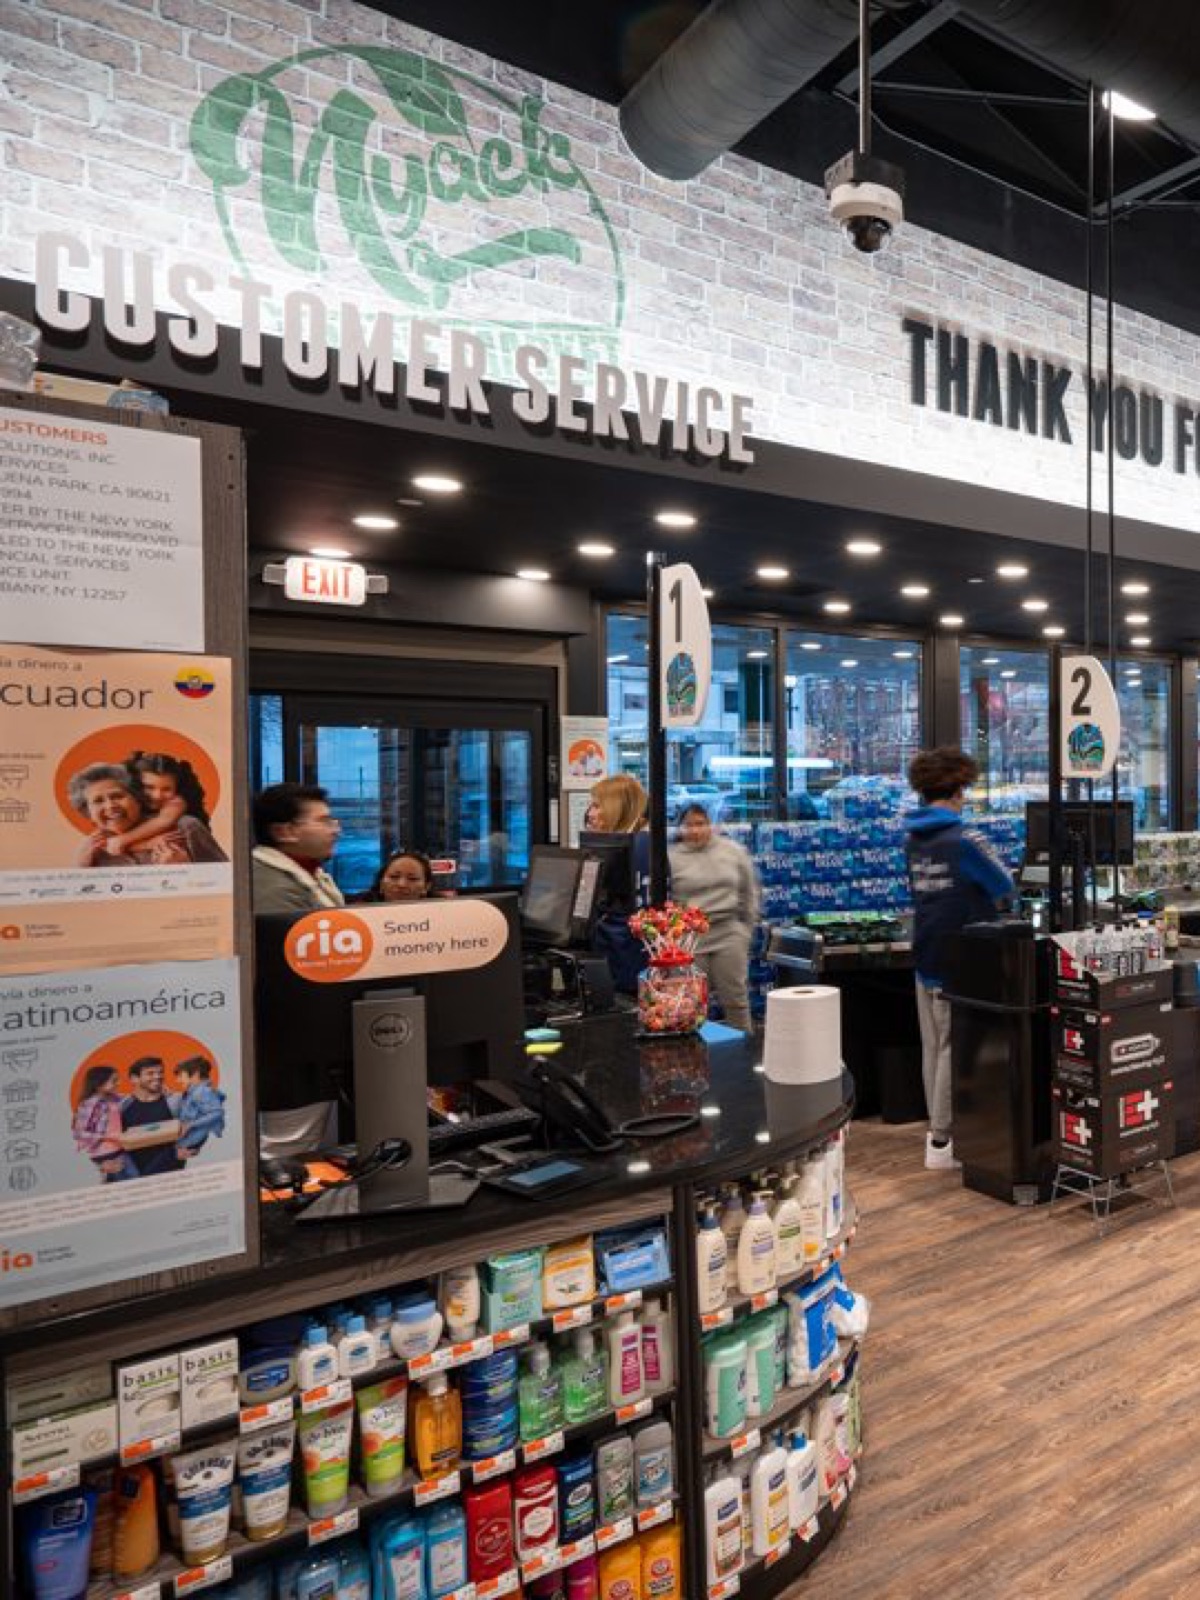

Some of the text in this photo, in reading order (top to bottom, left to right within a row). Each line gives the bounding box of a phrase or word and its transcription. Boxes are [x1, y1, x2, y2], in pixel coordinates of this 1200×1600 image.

[190, 73, 582, 310] Nyack
[34, 229, 754, 463] CUSTOMER SERVICE
[902, 317, 1073, 445] THANK
[1085, 374, 1163, 467] YOU
[99, 484, 120, 496] CA
[29, 506, 49, 518] BY
[55, 509, 85, 522] THE
[91, 512, 129, 527] NEW
[133, 517, 173, 531] YORK
[36, 538, 56, 550] TO
[62, 541, 89, 554] THE
[93, 544, 131, 557] NEW
[136, 548, 175, 562] YORK
[32, 570, 71, 581] UNIT
[54, 555, 130, 572] SERVICES
[302, 562, 353, 598] EXIT
[54, 587, 75, 599] NY
[668, 579, 683, 643] 1
[18, 658, 68, 671] dinero
[74, 662, 82, 671] a
[0, 680, 153, 710] cuador
[1071, 667, 1092, 716] 2
[384, 918, 430, 934] Send
[295, 920, 363, 959] ria
[385, 936, 489, 957] money here
[28, 984, 78, 998] dinero
[85, 984, 92, 993] a
[0, 988, 226, 1031] atinoamérica
[184, 1350, 233, 1372] basis
[123, 1366, 174, 1388] basis
